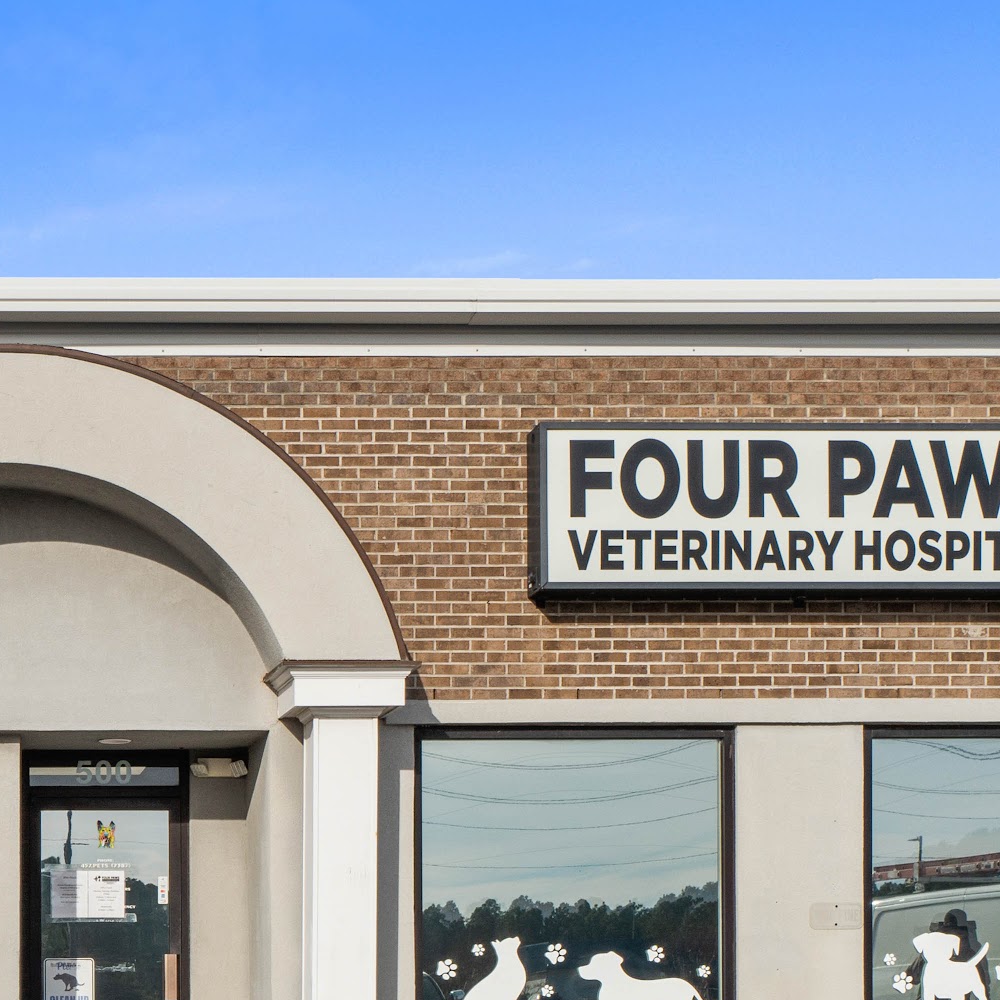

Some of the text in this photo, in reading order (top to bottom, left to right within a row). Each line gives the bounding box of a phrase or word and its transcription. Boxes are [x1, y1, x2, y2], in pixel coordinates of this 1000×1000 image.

[569, 438, 1000, 519] FOUR PAW
[568, 530, 844, 571] VETERINARY
[76, 760, 131, 784] 500
